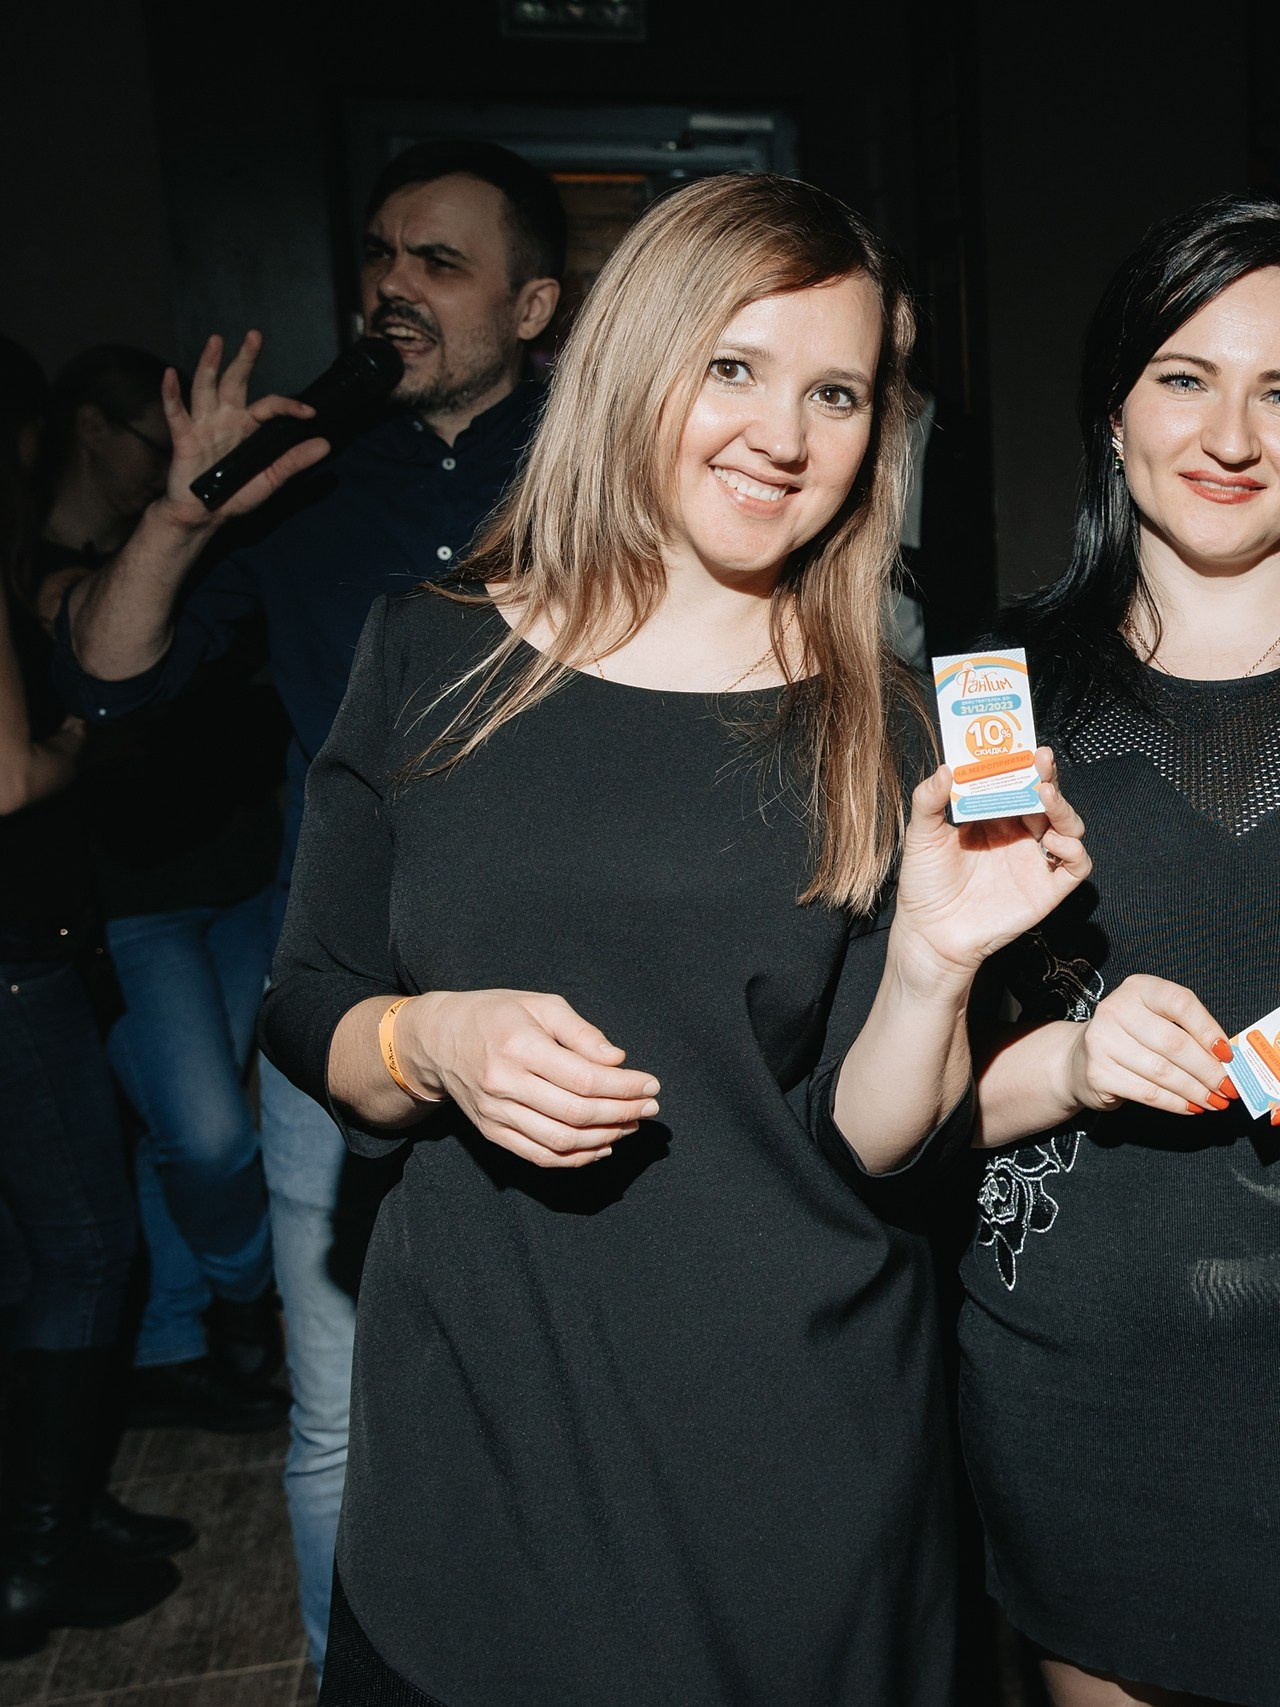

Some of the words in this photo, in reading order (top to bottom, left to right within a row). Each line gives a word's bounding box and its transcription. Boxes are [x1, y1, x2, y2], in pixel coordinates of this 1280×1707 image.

[960, 701, 1014, 715] 31/12/2023
[968, 719, 1012, 747] 10%
[974, 746, 1009, 757] СКИДКА
[955, 768, 968, 778] НА
[969, 755, 1031, 775] МЕРОПРИЯТИЕ
[1252, 1032, 1261, 1041] НА
